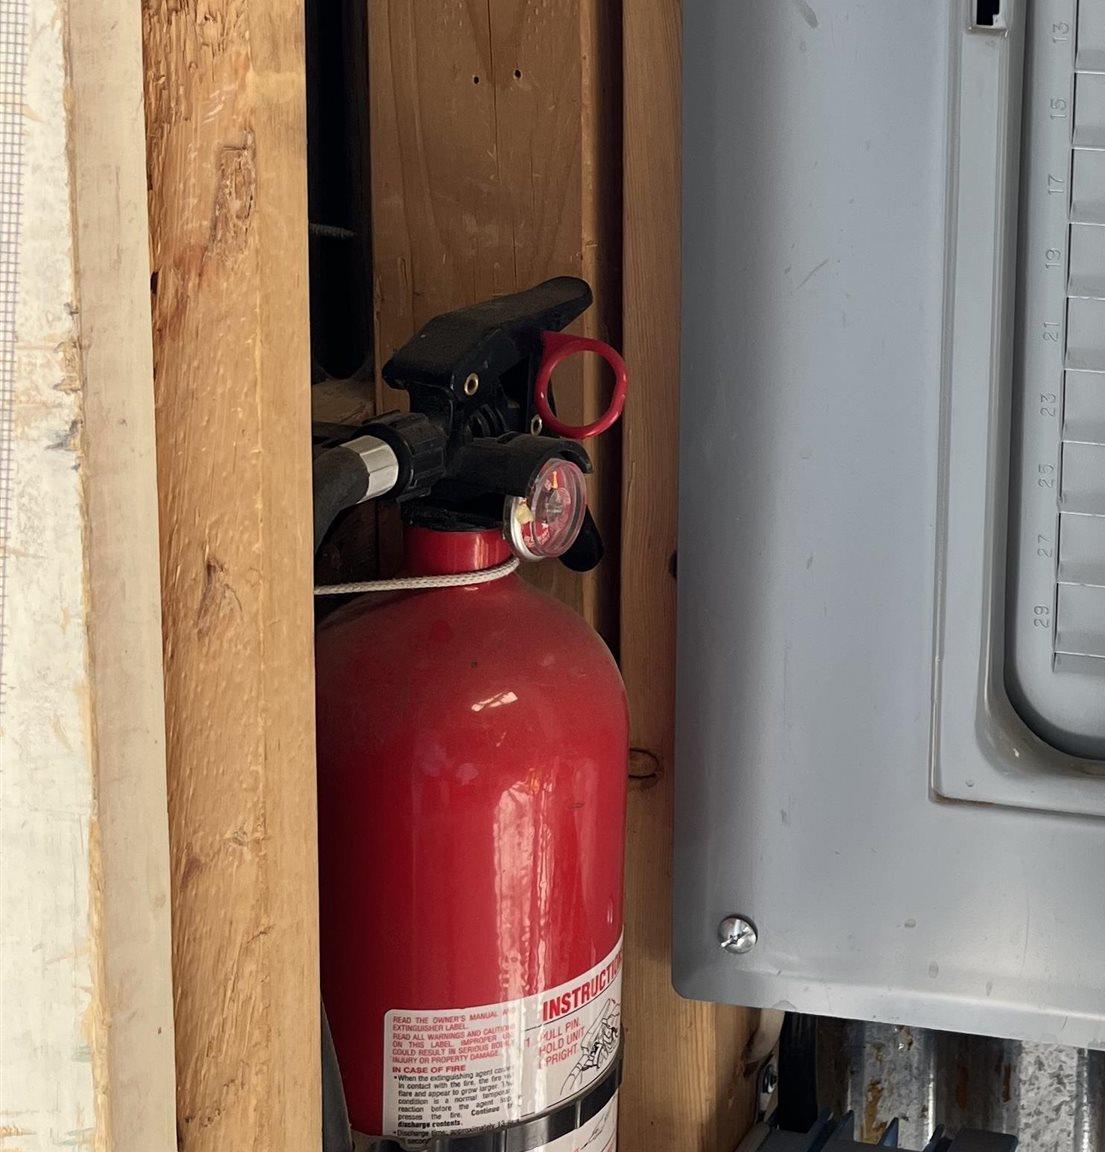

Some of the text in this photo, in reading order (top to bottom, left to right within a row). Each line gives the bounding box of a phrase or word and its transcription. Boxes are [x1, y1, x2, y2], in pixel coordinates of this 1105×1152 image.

[1052, 22, 1070, 43] 13
[1051, 98, 1067, 120] 15
[1048, 175, 1064, 195] 17
[1046, 248, 1061, 269] 19
[1043, 322, 1059, 343] 21
[1040, 393, 1056, 416] 23
[1039, 465, 1054, 487] 25
[1037, 535, 1052, 557] 27
[1034, 605, 1050, 628] 29
[542, 950, 622, 1021] INSTRUCTI
[470, 1011, 498, 1021] MANUAL
[428, 1032, 465, 1040] WARNINGS
